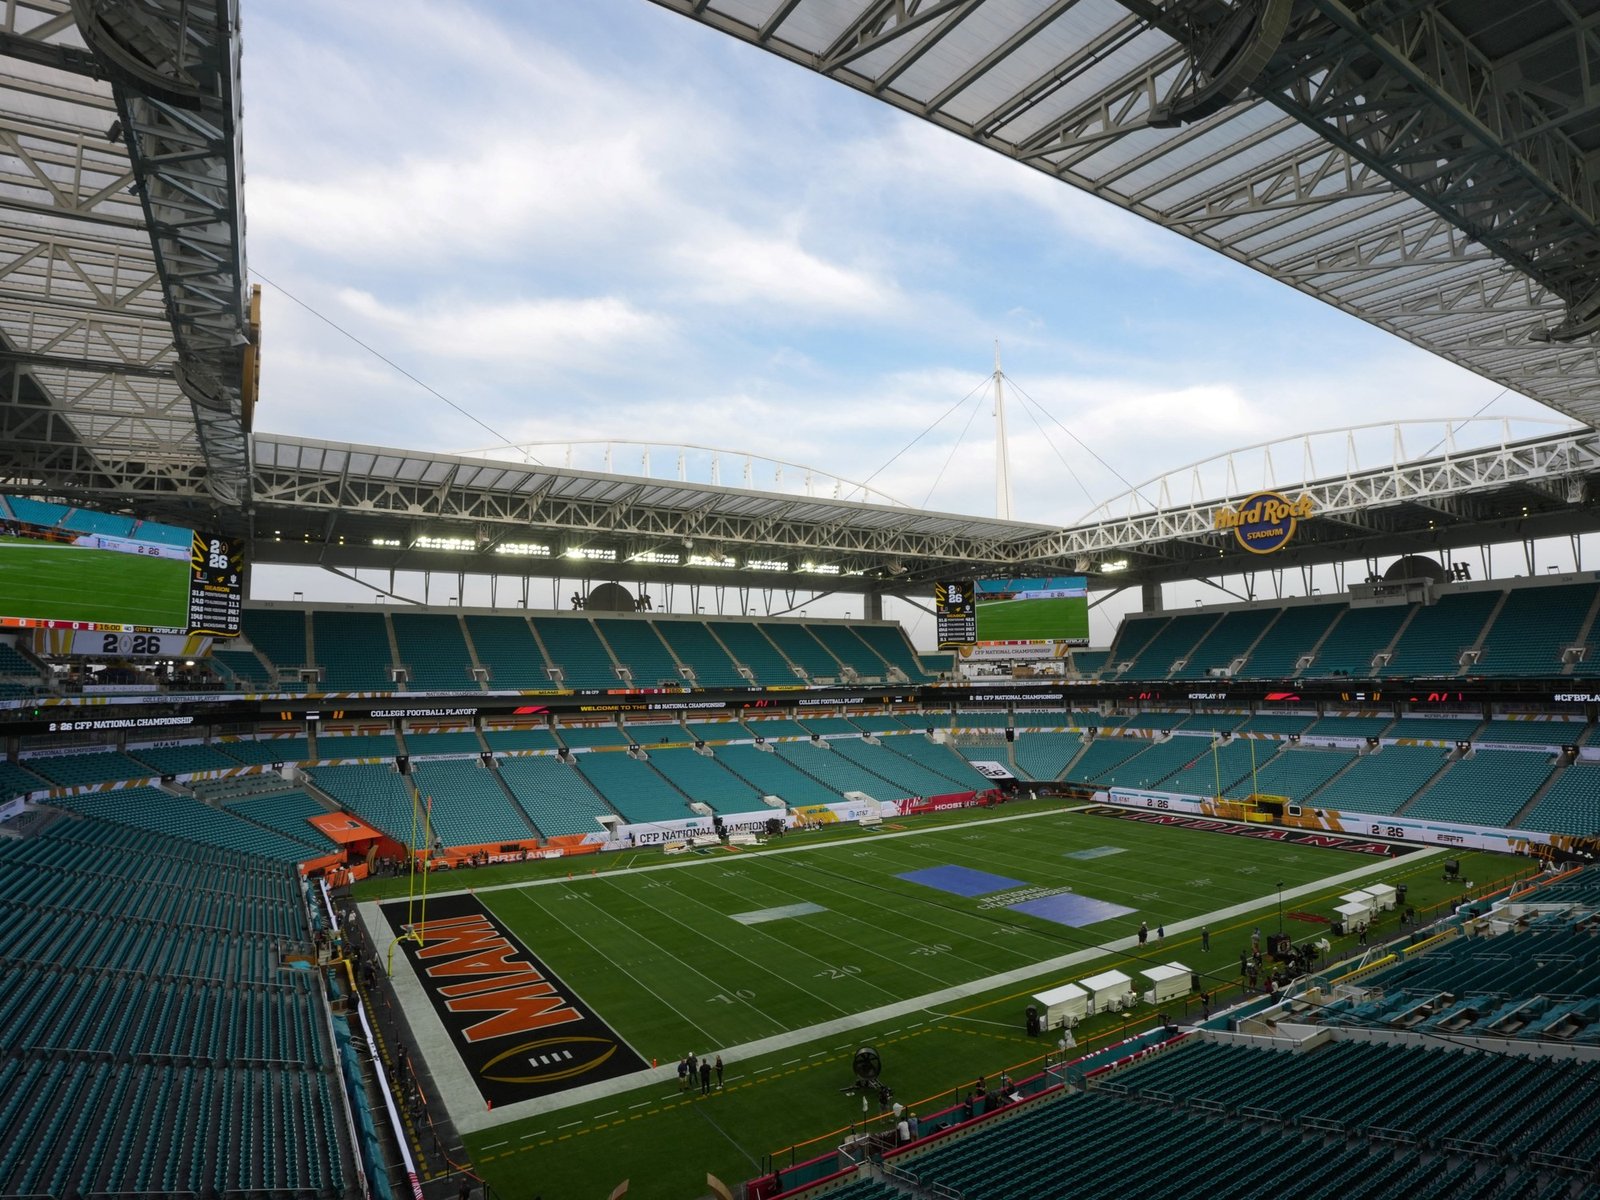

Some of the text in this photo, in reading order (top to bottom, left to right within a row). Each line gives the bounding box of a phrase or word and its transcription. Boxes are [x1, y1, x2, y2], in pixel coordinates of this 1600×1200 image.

[1214, 494, 1313, 529] Hard Rock
[1247, 528, 1283, 540] STADIUM
[209, 553, 228, 569] 26
[204, 585, 230, 593] SEASON
[949, 594, 963, 603] 26
[75, 722, 92, 730] CFP
[93, 720, 136, 729] NATIONAL
[136, 716, 194, 727] CHAMPIONSHIP
[640, 819, 786, 843] CFP NATIONAL AMPIONP
[1123, 812, 1391, 855] INDIANA
[1437, 834, 1464, 842] ESPN
[400, 914, 585, 1043] MIAMI
[821, 965, 862, 979] 20
[715, 989, 757, 1005] 10
